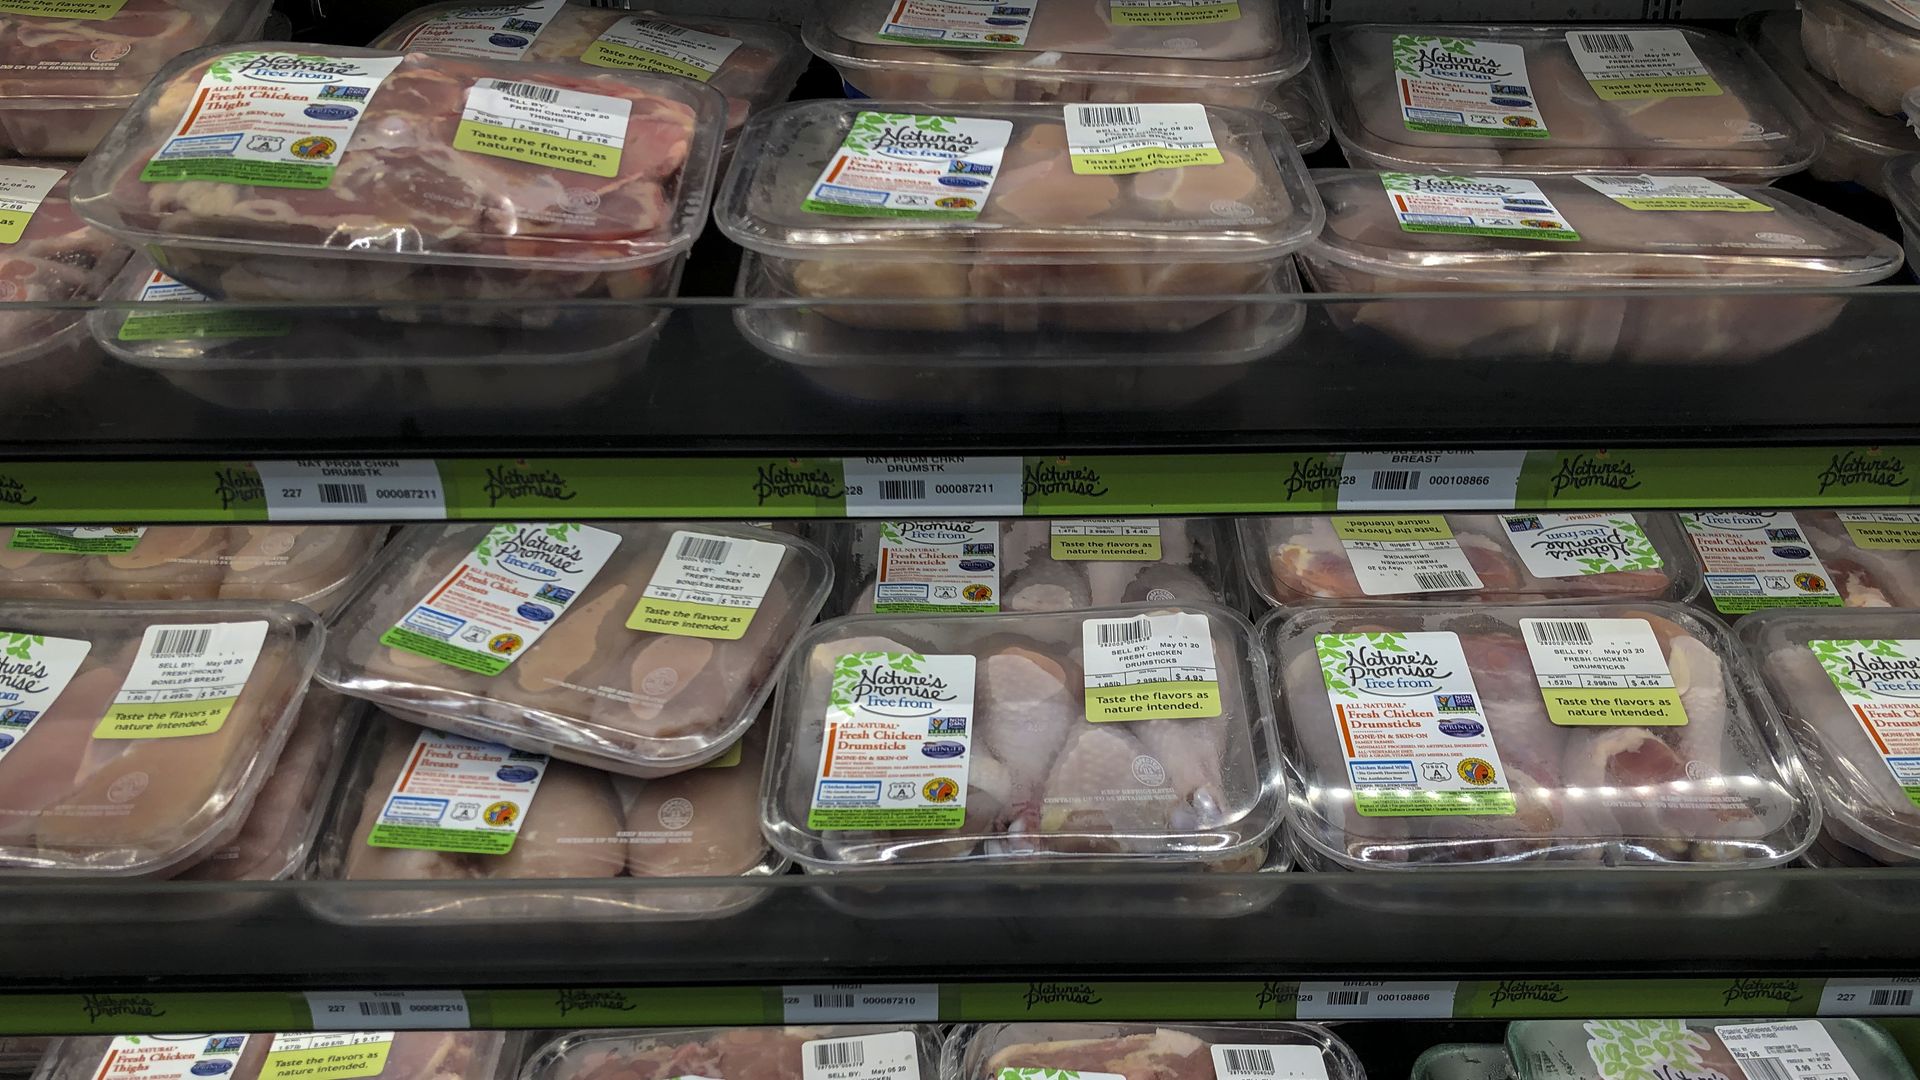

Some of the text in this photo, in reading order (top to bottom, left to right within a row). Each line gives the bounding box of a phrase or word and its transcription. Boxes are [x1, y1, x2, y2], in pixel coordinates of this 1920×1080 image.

[599, 47, 684, 74] Taste the flavors
[600, 56, 635, 66] nature
[209, 91, 309, 101] Fresh Chicken
[205, 100, 251, 111] Thighs
[880, 125, 978, 147] Nature's
[471, 129, 607, 161] Taste the flavors as
[476, 140, 597, 168] nature intended.
[889, 163, 941, 176] Chicken
[1392, 455, 1441, 464] BREAST
[1830, 451, 1904, 475] Nature's
[322, 468, 382, 477] DRUMSTK
[887, 464, 945, 473] DRUMSTK
[1024, 464, 1100, 482] Nature's
[1559, 458, 1635, 476] Nature's
[486, 464, 567, 491] Nature's
[757, 464, 835, 485] Nature's
[1429, 476, 1490, 486] 000108866
[1551, 472, 1642, 498] Promise
[1818, 470, 1909, 495] Promise
[282, 488, 302, 498] 227
[376, 489, 437, 499] 000087211
[752, 482, 842, 506] Promise
[934, 484, 994, 494] 000087211
[1021, 479, 1109, 504] Promise
[1706, 516, 1763, 525] Free from
[900, 521, 984, 542] Promise
[910, 531, 966, 539] Free from
[516, 528, 583, 561] Nature's
[1107, 540, 1139, 548] flavors
[1696, 537, 1767, 547] Fresh Chicken
[494, 543, 584, 574] Promise
[890, 552, 959, 560] Fresh Chicken
[502, 554, 557, 578] Free from
[456, 580, 489, 596] Breasts
[463, 572, 529, 599] Fresh Chicken
[644, 606, 671, 617] Taste
[693, 613, 728, 622] flavors
[644, 617, 730, 631] nature intended.
[1112, 648, 1132, 656] SELL
[1119, 654, 1145, 662] FRESH
[1346, 646, 1438, 666] Nature's
[206, 660, 225, 668] May
[1125, 658, 1177, 668] DRUMSTICKS
[859, 665, 948, 689] Nature's
[1342, 665, 1453, 686] Promise
[1365, 678, 1433, 689] Free from
[1875, 681, 1906, 691] Free
[852, 682, 957, 703] Promise
[1096, 696, 1126, 704] Taste
[1130, 694, 1149, 702] the
[1153, 692, 1193, 700] flavors
[867, 696, 933, 709] Free from
[1555, 697, 1671, 706] Taste the flavors as
[1104, 702, 1203, 714] nature intended.
[1348, 710, 1435, 718] Fresh Chicken
[1568, 708, 1669, 717] nature intended.
[1868, 710, 1901, 718] Fresh
[115, 708, 221, 721] Taste the flavors as
[114, 719, 208, 731] nature intended.
[1351, 720, 1422, 729] Drumsticks
[839, 731, 922, 741] Fresh Chicken
[838, 741, 907, 751] Drumsticks
[424, 750, 502, 762] Fresh Chicken
[421, 759, 460, 768] Breasts
[1500, 980, 1564, 992] Nature's
[1023, 992, 1102, 1011] Promise
[1489, 990, 1568, 1008] Promise
[1722, 988, 1803, 1006] Promise
[1837, 993, 1855, 1001] 227
[116, 1053, 196, 1064] Fresh Chicken
[275, 1060, 303, 1068] Taste
[306, 1057, 323, 1065] the
[327, 1052, 363, 1062] flavors
[113, 1065, 149, 1073] Thighs
[277, 1062, 368, 1076] nature intended.
[871, 1068, 886, 1076] May
